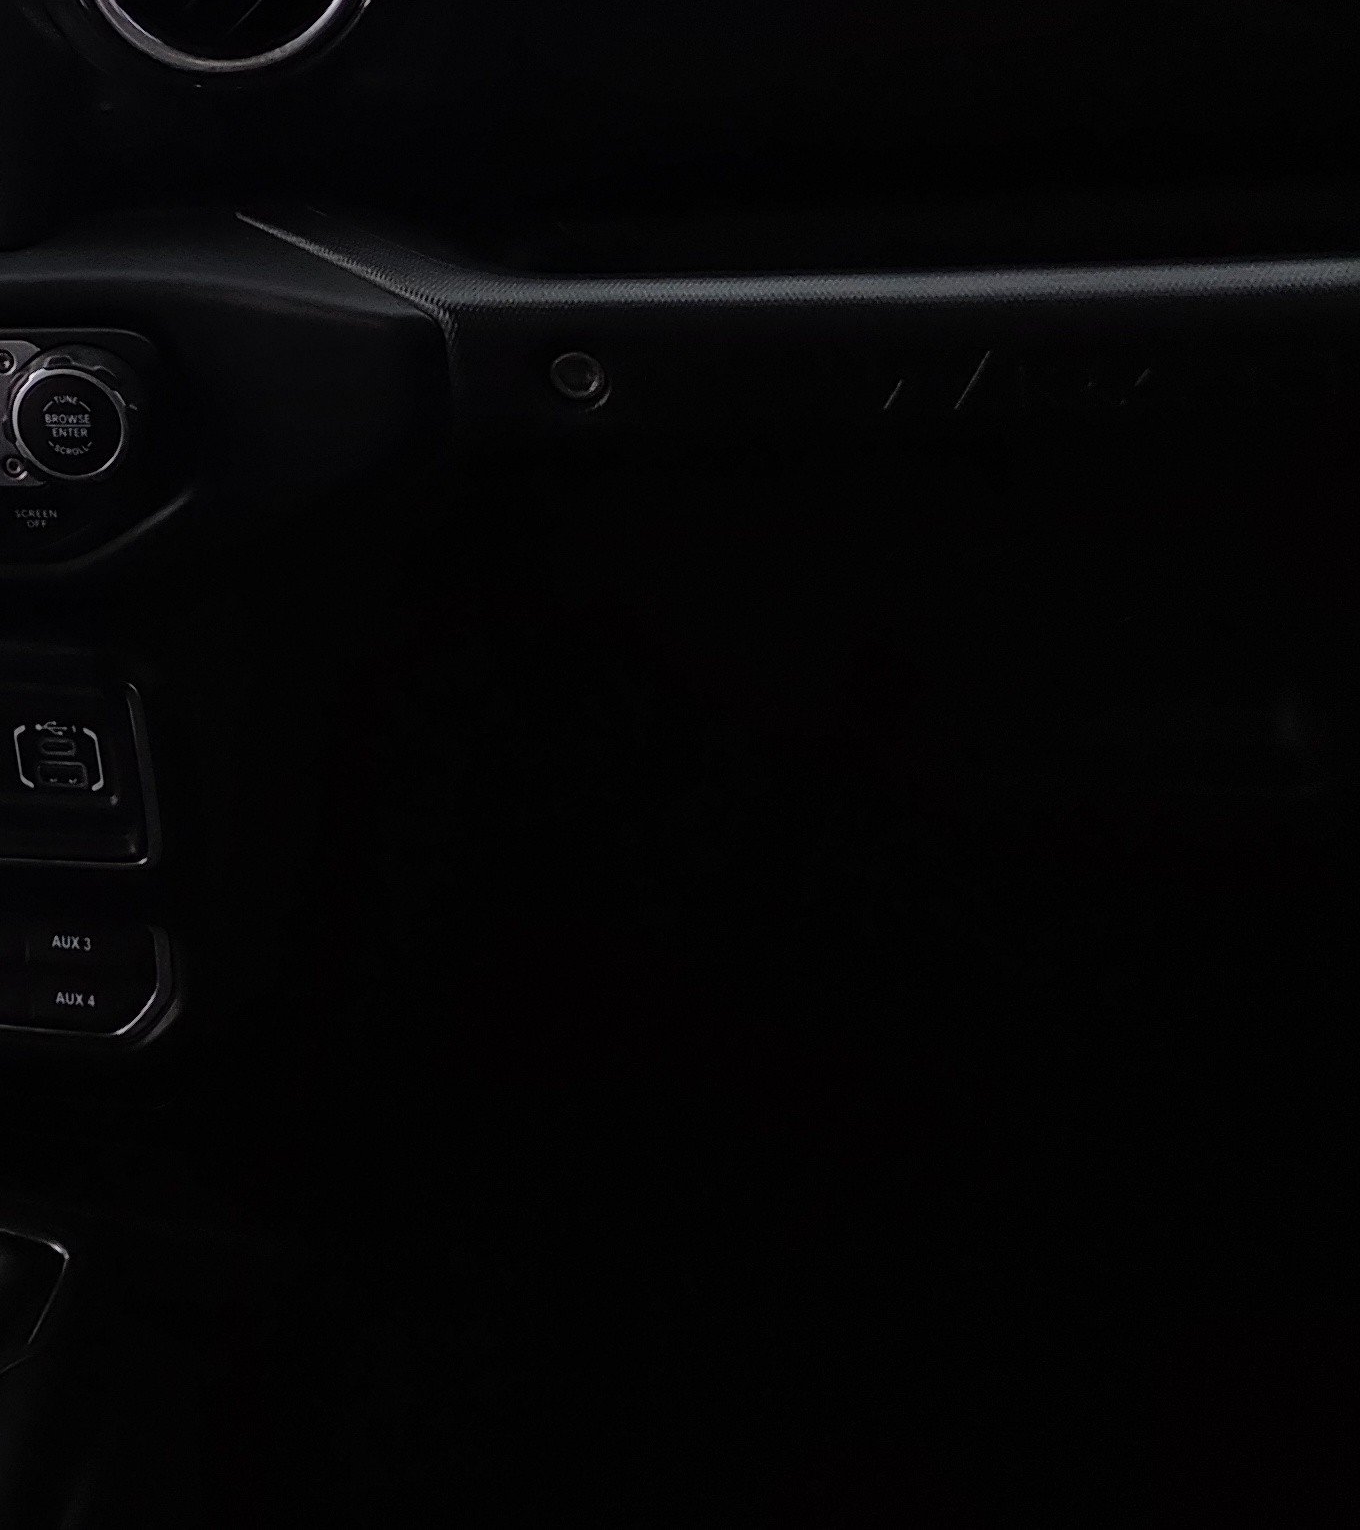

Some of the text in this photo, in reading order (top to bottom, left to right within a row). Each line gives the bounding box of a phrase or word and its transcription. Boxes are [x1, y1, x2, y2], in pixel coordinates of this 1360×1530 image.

[53, 395, 80, 405] TUNE
[44, 413, 91, 425] BROWSE
[51, 427, 89, 439] ENTER
[14, 509, 58, 519] SCREEN
[51, 934, 92, 952] AUX 3
[55, 991, 96, 1008] AUX 4
